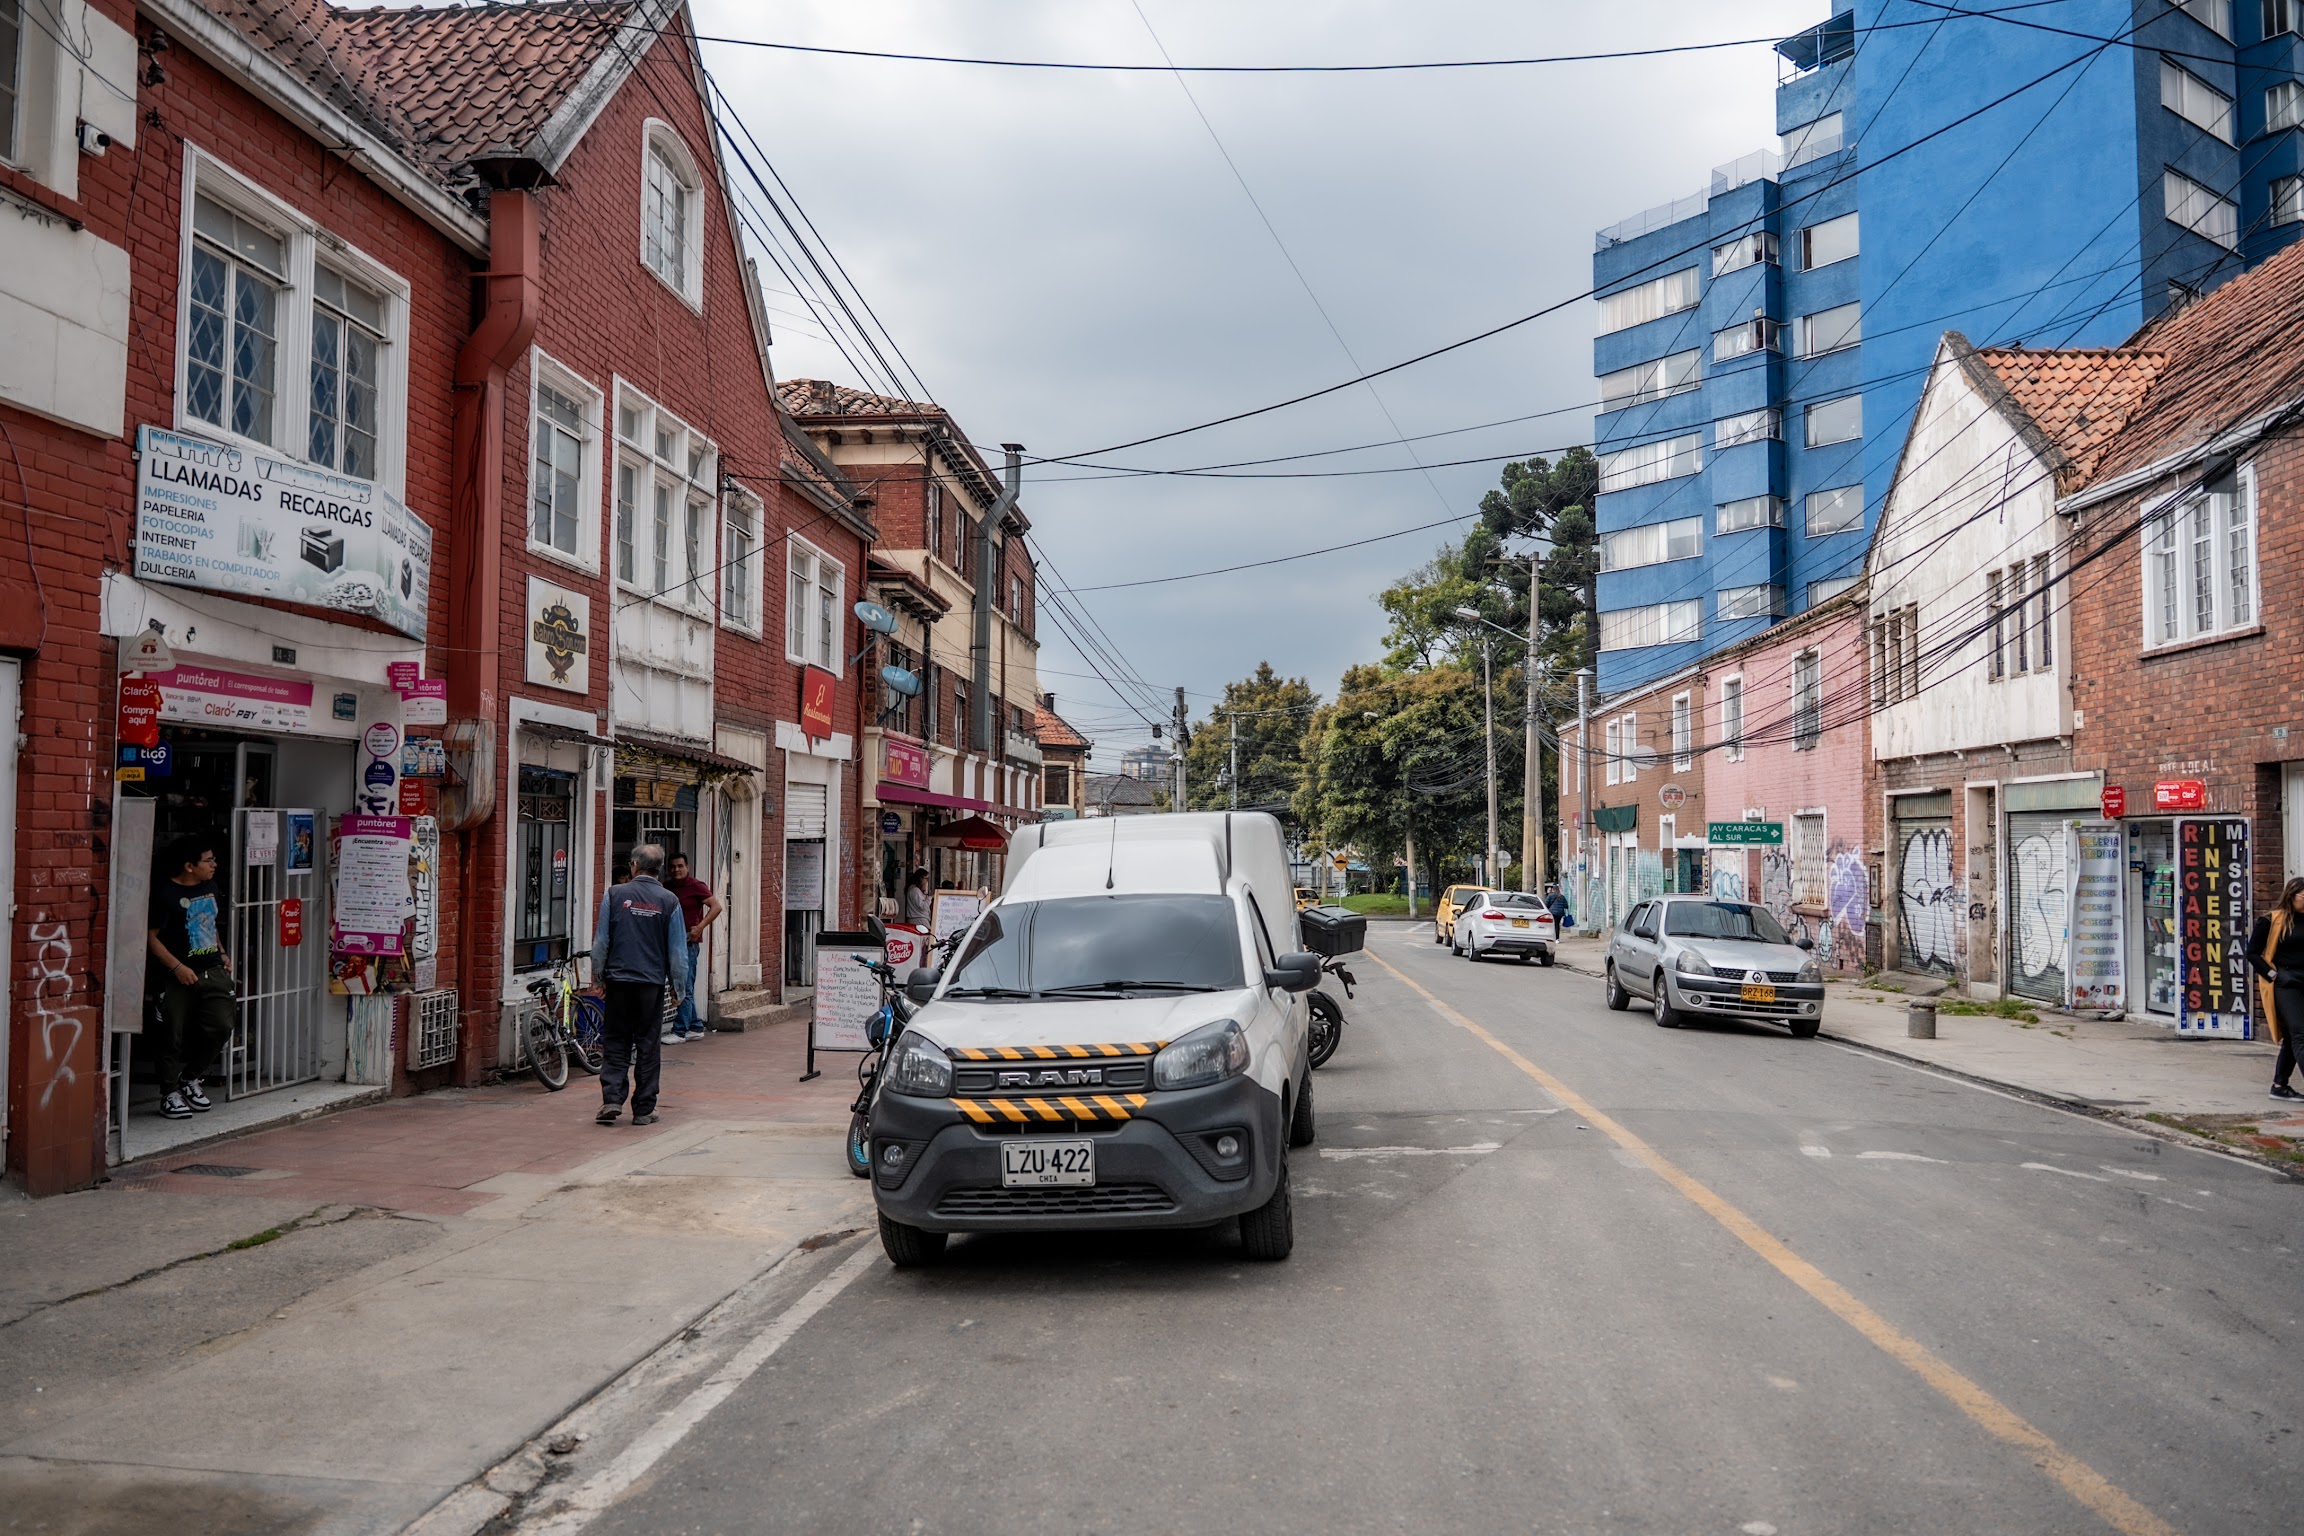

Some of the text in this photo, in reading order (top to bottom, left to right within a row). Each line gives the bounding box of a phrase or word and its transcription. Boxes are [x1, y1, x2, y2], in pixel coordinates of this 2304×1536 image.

[148, 428, 373, 505] NATTY'S VARIEDADES
[144, 485, 217, 511] IMPRESIONES
[150, 459, 373, 528] LLAMADAS RECARGAS
[143, 500, 205, 524] PAPELERIA
[142, 515, 215, 539] FOTOCOPIAS
[141, 530, 197, 551] INTERNET
[381, 515, 430, 567] LLAMADAS RECARGAS
[140, 560, 197, 581] DULCERIA
[142, 546, 281, 581] TRABAJOS EN COMPUTADOR
[122, 686, 150, 697] Claro
[227, 679, 233, 688] El
[234, 681, 268, 694] corresponsal
[268, 686, 275, 694] de
[275, 687, 289, 696] todos
[122, 705, 155, 717] Compra
[205, 703, 233, 719] Claro
[236, 709, 258, 720] PAY
[128, 715, 148, 727] aquí
[2181, 760, 2217, 774] LOCAL
[2182, 791, 2196, 801] Claro
[1711, 833, 1723, 841] AL
[1725, 825, 1768, 833] CARACAS
[2184, 824, 2203, 1010] RECARGAS
[2204, 824, 2223, 1011] INTERNET
[2226, 824, 2247, 1013] MISCELANEA
[887, 942, 909, 952] Crem
[998, 1069, 1102, 1087] RAM
[1039, 1175, 1059, 1183] CHIA
